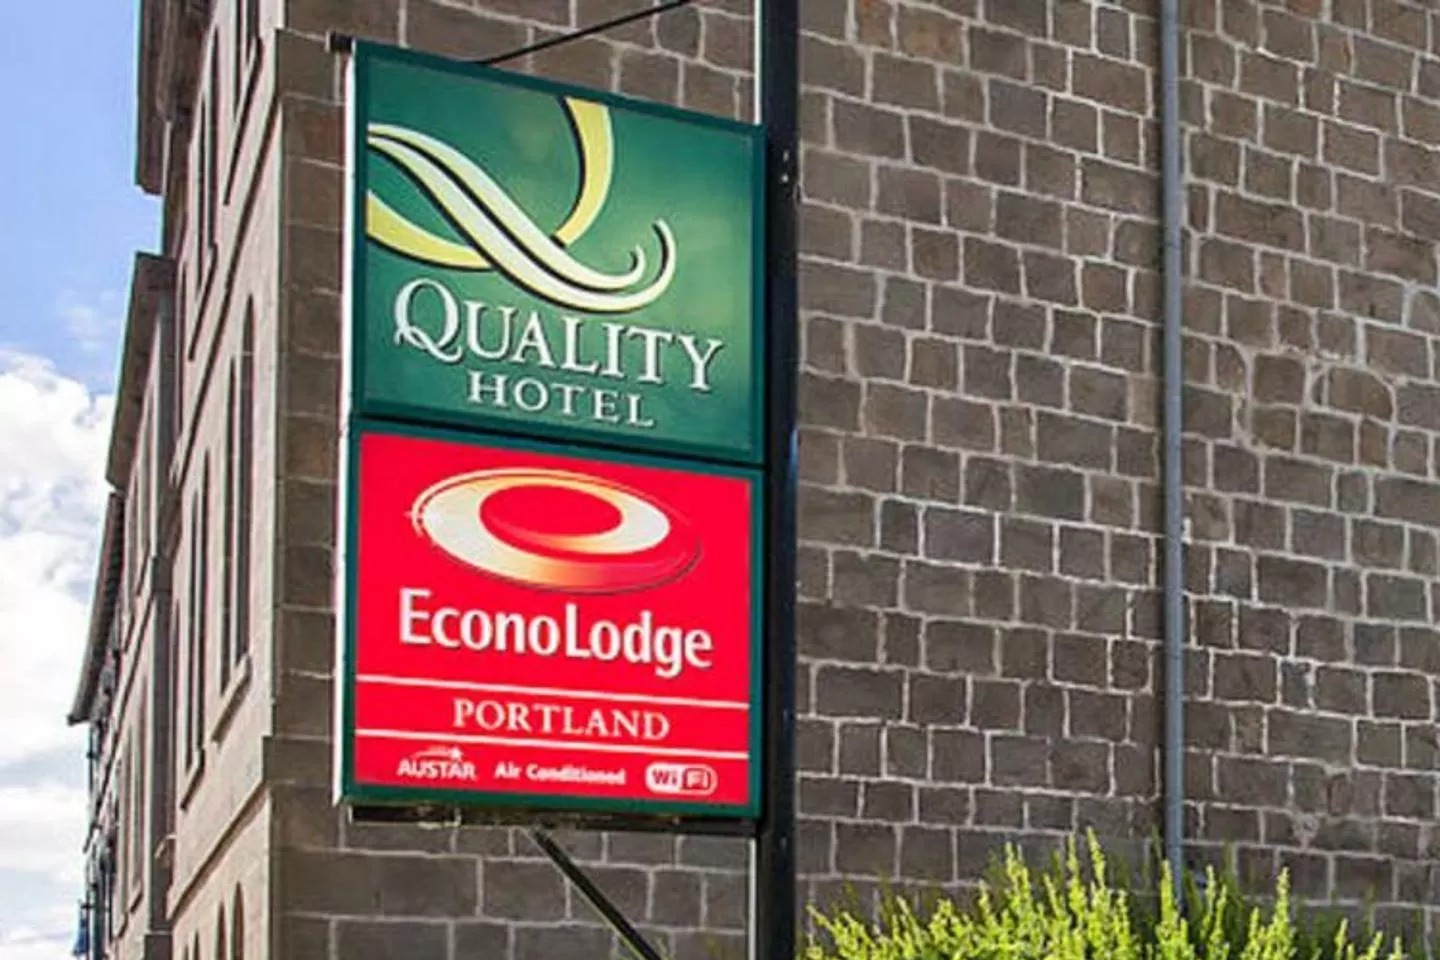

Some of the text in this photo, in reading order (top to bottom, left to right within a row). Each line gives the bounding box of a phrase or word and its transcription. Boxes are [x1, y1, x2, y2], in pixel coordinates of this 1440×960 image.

[395, 277, 723, 391] QUALITY
[469, 370, 654, 427] HOTEL
[400, 588, 712, 678] EconoLodge
[454, 699, 670, 740] PORTLAND
[397, 758, 477, 782] AUSTAR
[494, 760, 520, 780] Air
[527, 763, 626, 785] Conditioned
